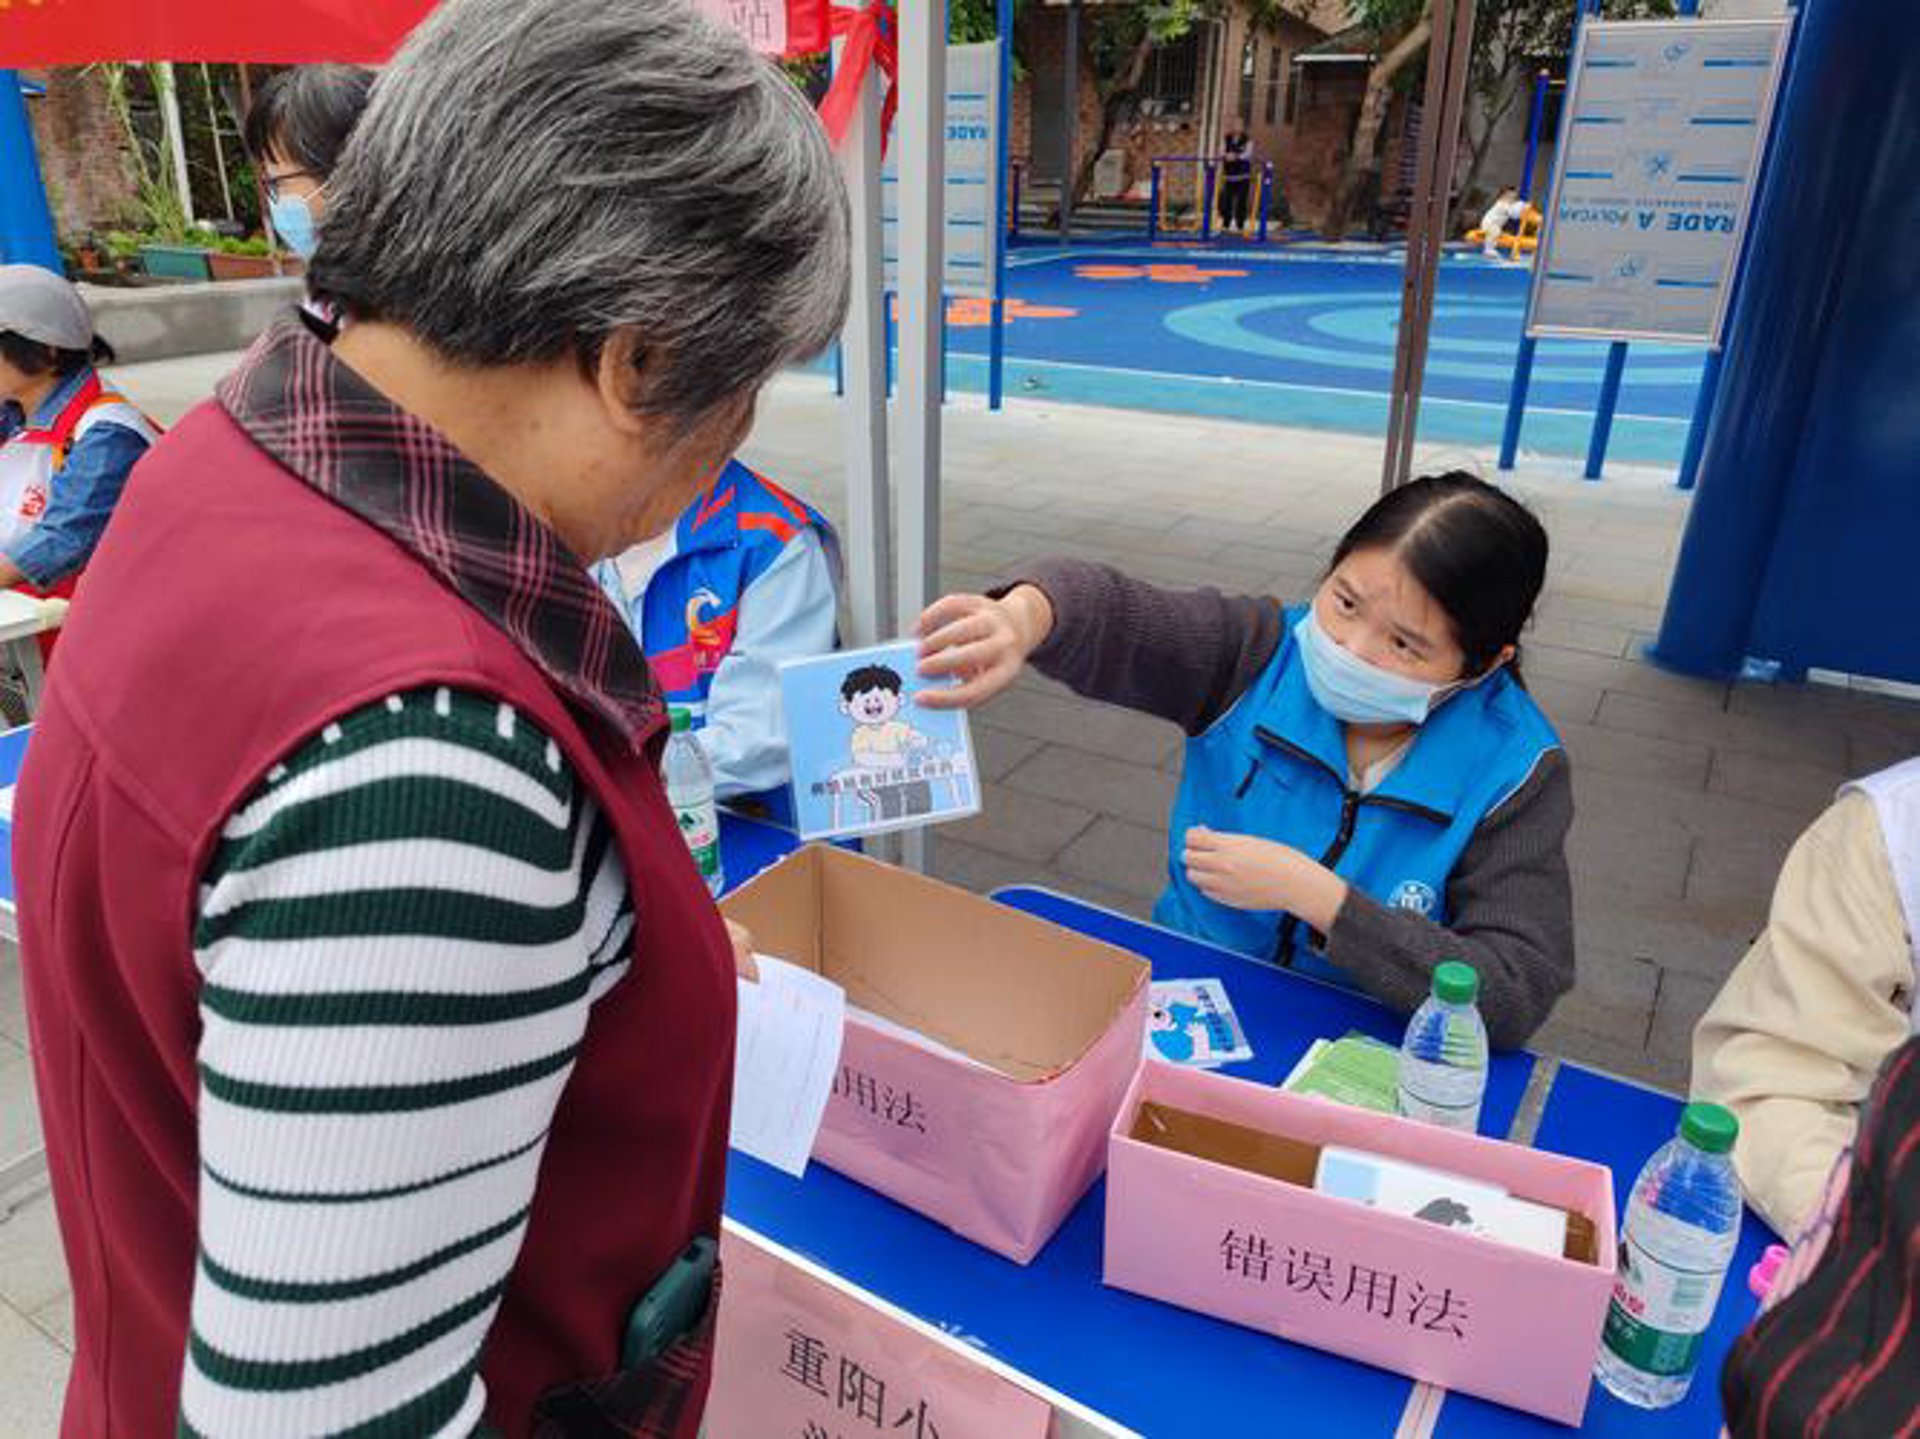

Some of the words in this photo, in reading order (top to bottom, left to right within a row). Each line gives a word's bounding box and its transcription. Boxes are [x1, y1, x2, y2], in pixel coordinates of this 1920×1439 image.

[832, 1066, 926, 1133] 用法
[1219, 1229, 1469, 1338] 错误用法
[781, 1327, 940, 1439] 重阳小
